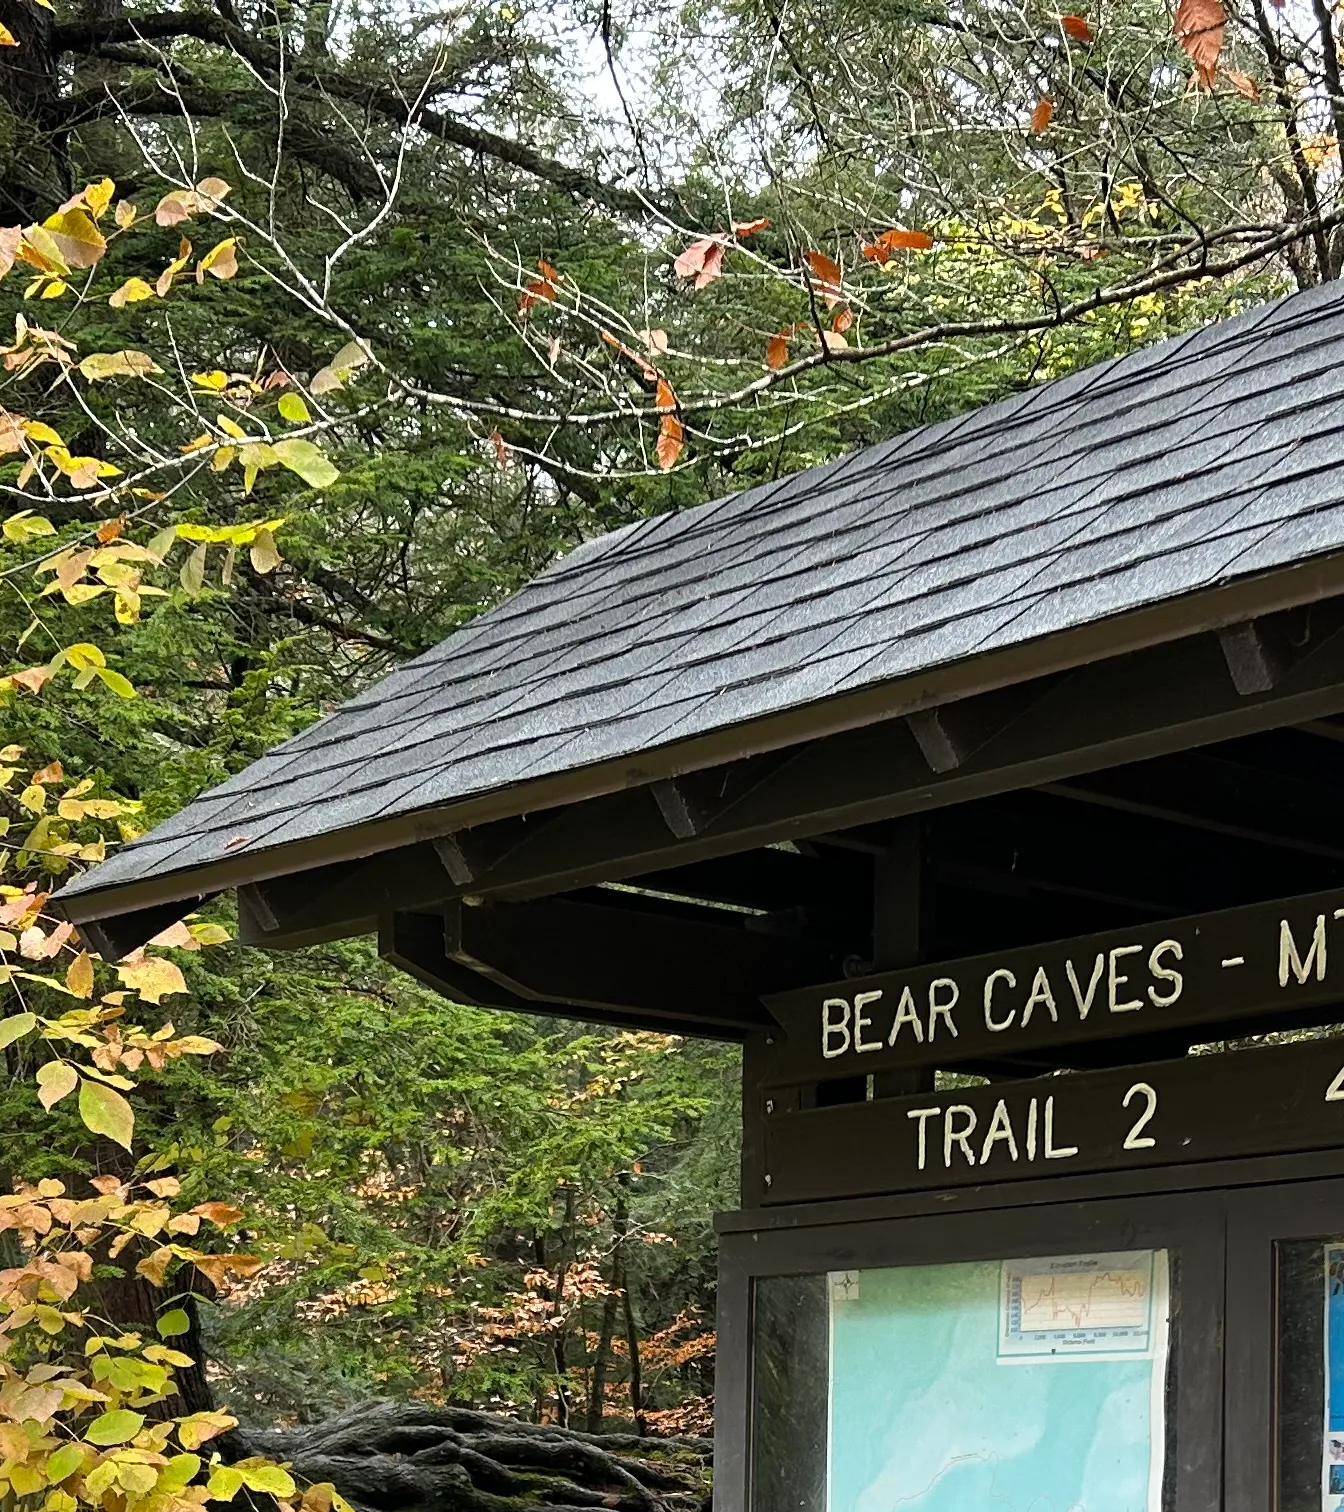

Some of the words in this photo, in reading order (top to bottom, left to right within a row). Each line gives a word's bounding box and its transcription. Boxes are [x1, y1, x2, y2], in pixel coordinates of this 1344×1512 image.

[821, 977, 959, 1059] BEAR
[984, 939, 1183, 1032] CAVES
[907, 1095, 1078, 1170] TRAIL
[1122, 1082, 1157, 1149] 2
